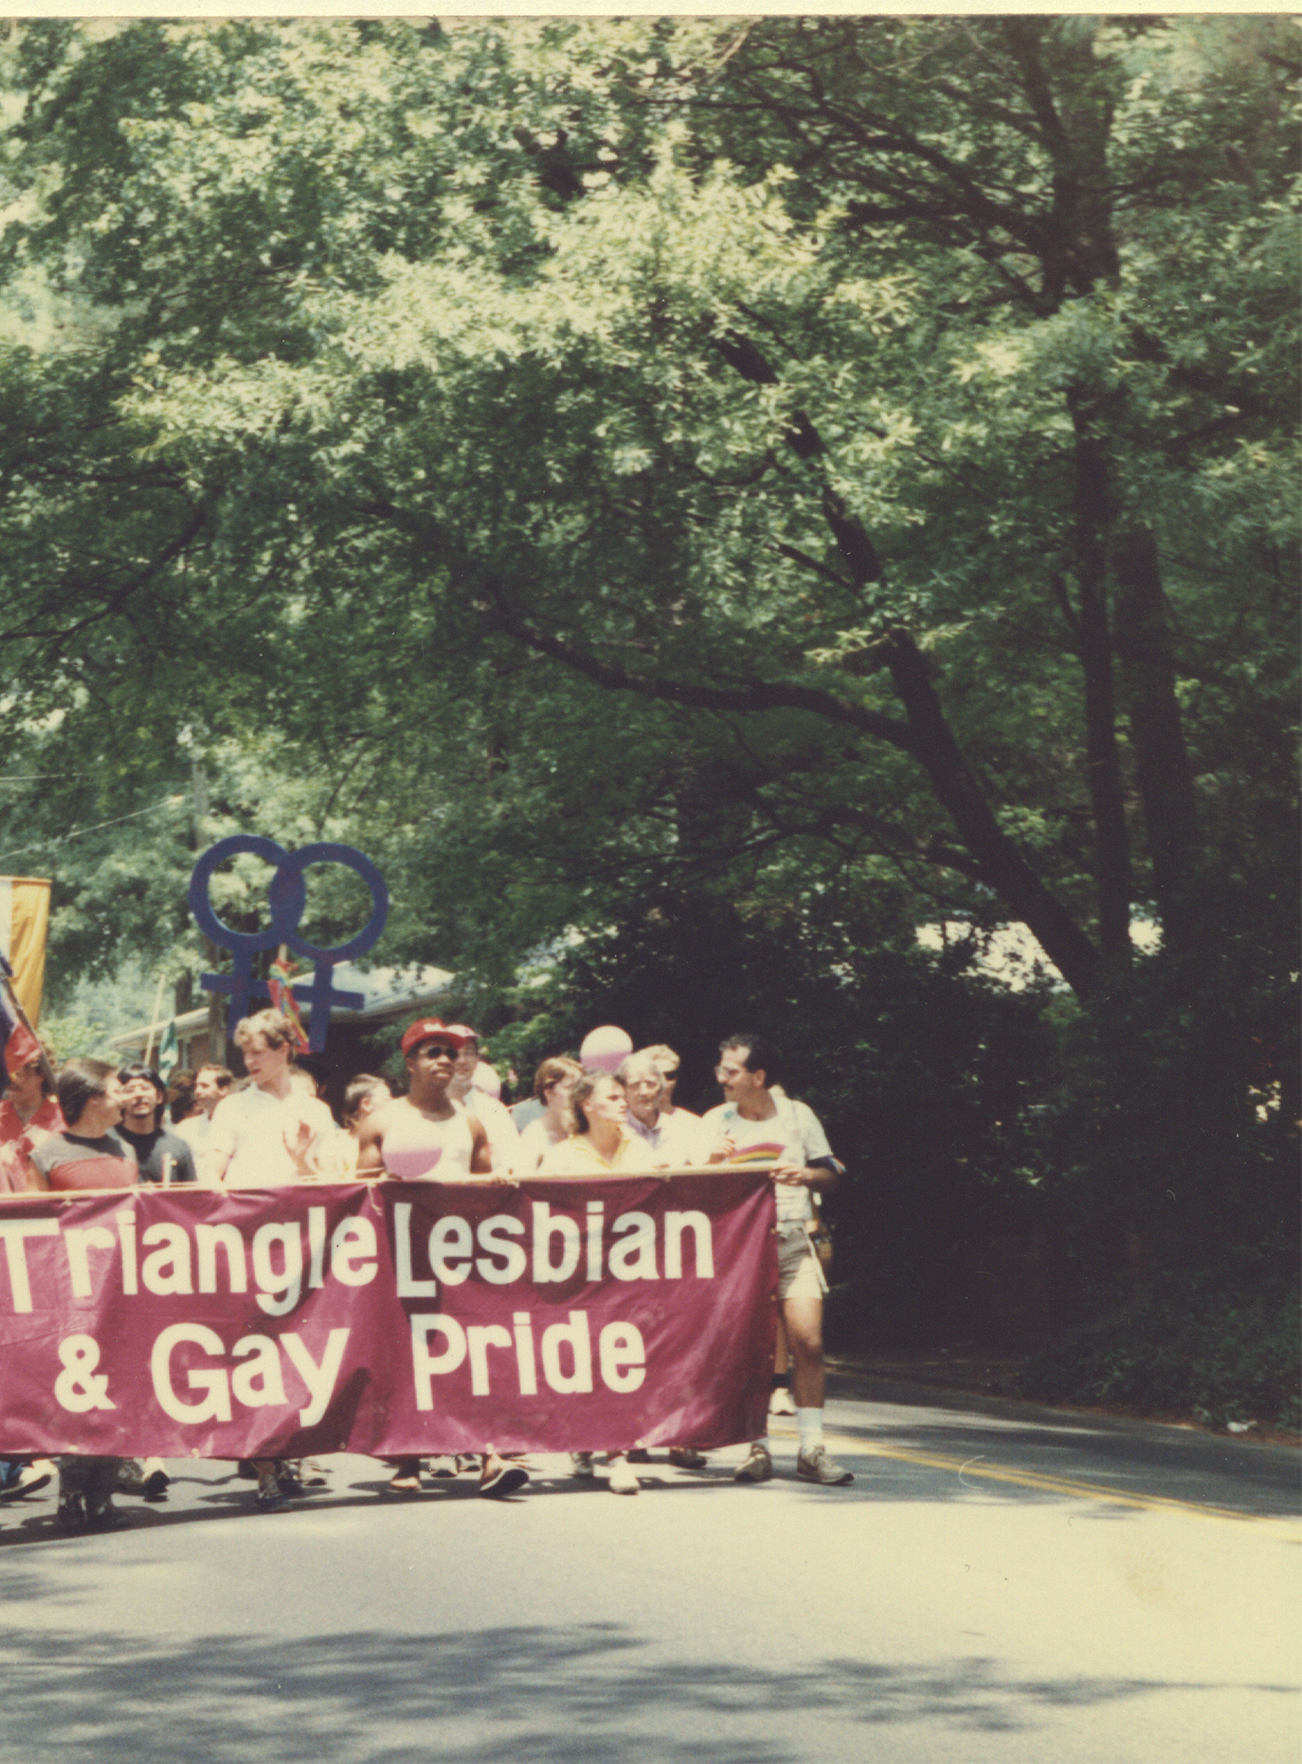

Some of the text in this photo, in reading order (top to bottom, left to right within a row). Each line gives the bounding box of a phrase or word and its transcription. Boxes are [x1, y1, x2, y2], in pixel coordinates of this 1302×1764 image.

[395, 1201, 715, 1298] Lesbian
[54, 1310, 647, 1428] & Gay Pride
